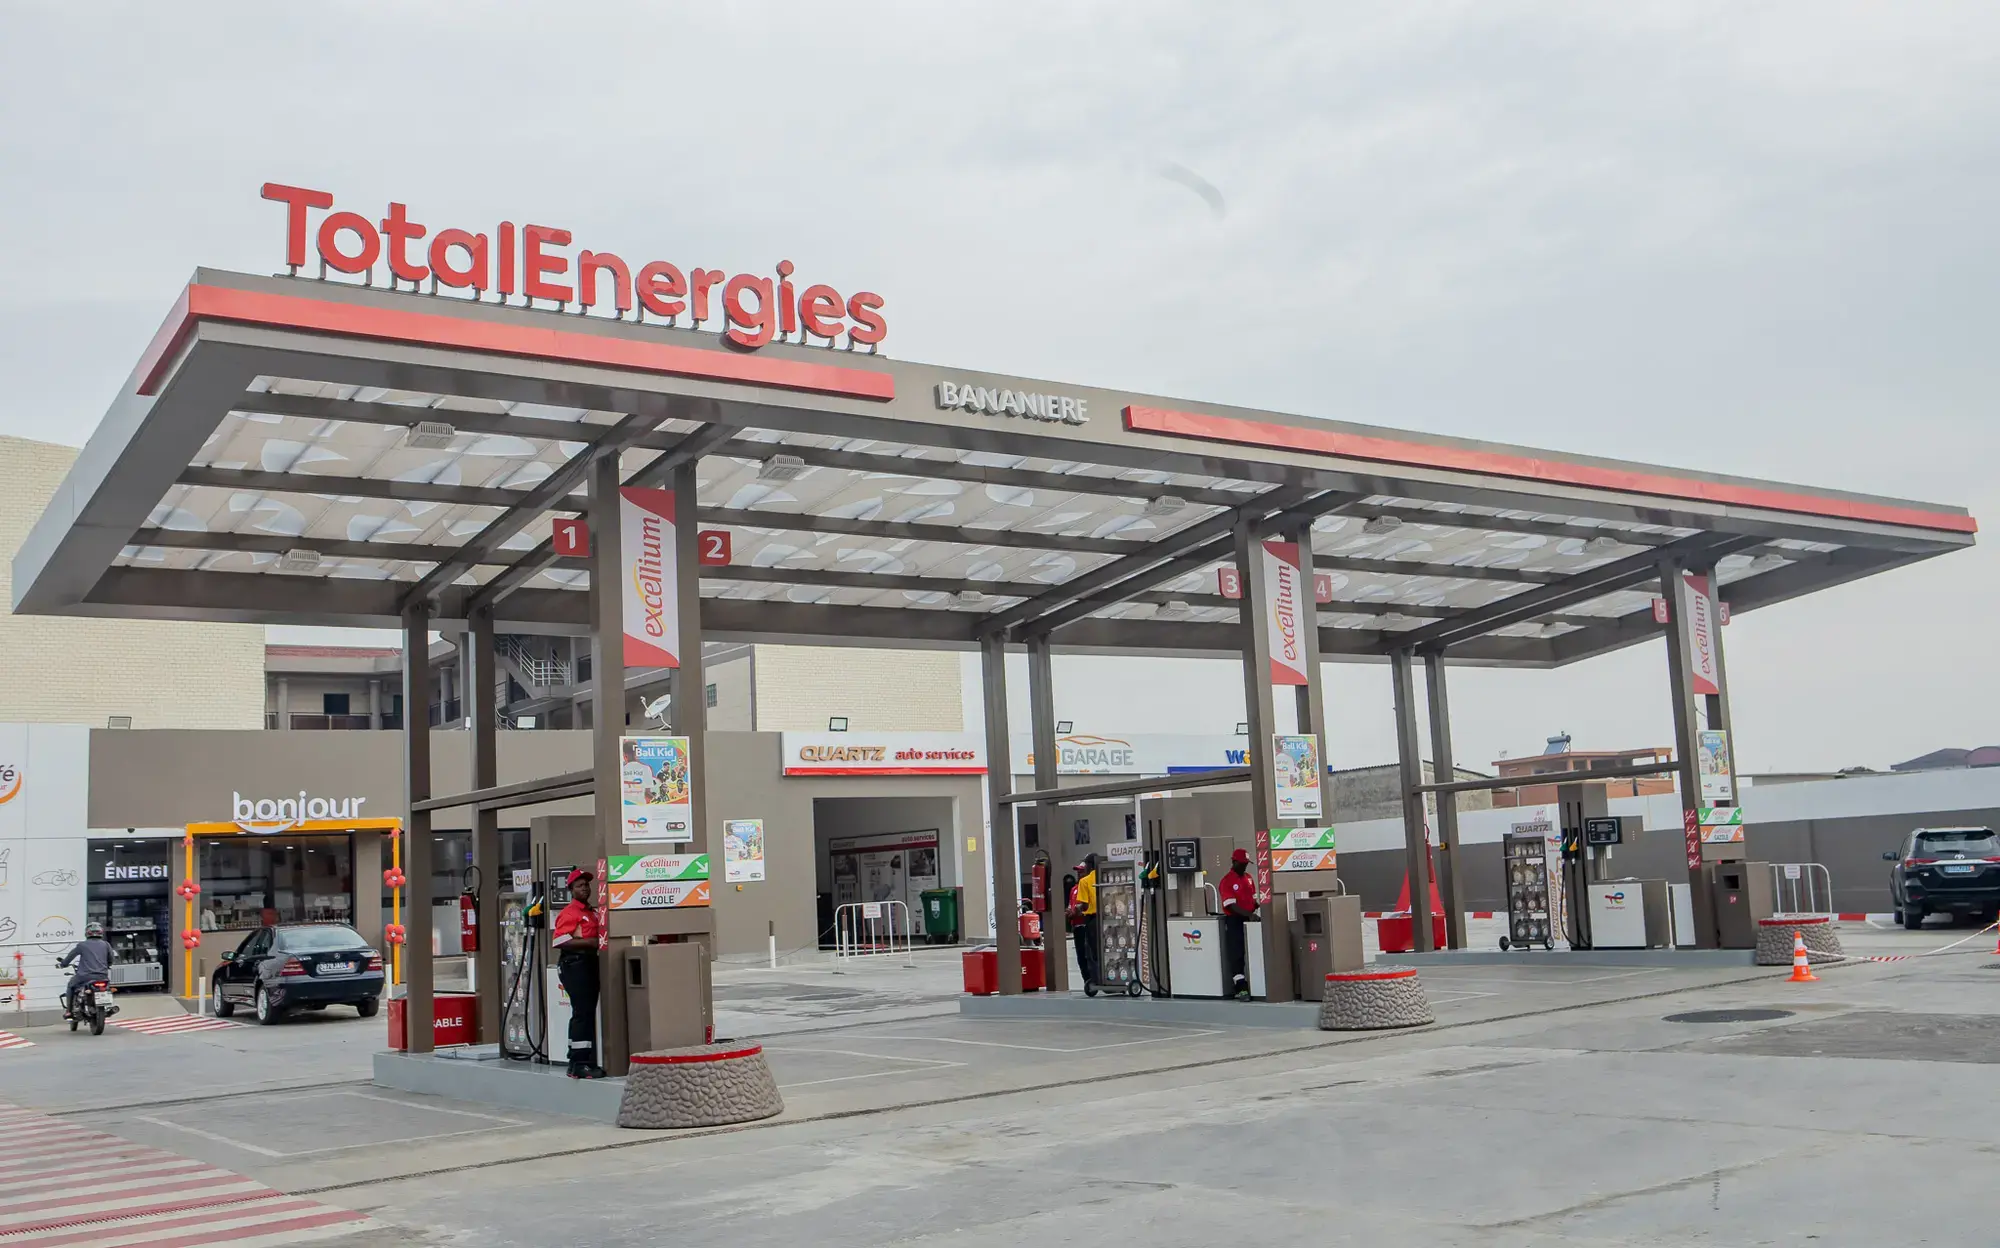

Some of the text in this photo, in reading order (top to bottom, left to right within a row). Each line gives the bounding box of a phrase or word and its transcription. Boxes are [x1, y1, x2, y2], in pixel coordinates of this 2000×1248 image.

[260, 182, 888, 348] TotalEnergies
[938, 381, 1090, 423] BANANIERE
[562, 526, 576, 549] 1
[706, 536, 724, 559] 2
[638, 517, 664, 637] excellium
[1226, 575, 1238, 593] 3
[1316, 580, 1328, 597] 4
[1277, 565, 1297, 661] excellium
[1695, 595, 1711, 674] excellium
[635, 747, 674, 757] Ball Kid
[800, 746, 886, 762] QUARTZ
[895, 748, 975, 760] auto services
[1282, 742, 1295, 750] Ball
[1062, 748, 1134, 766] GARAGE
[232, 790, 366, 827] bonjour
[1515, 824, 1549, 833] QUARTZ
[641, 858, 680, 868] excellium
[641, 885, 681, 895] excellium
[640, 895, 675, 905] GAZOLE
[433, 1017, 463, 1028] ABLE
